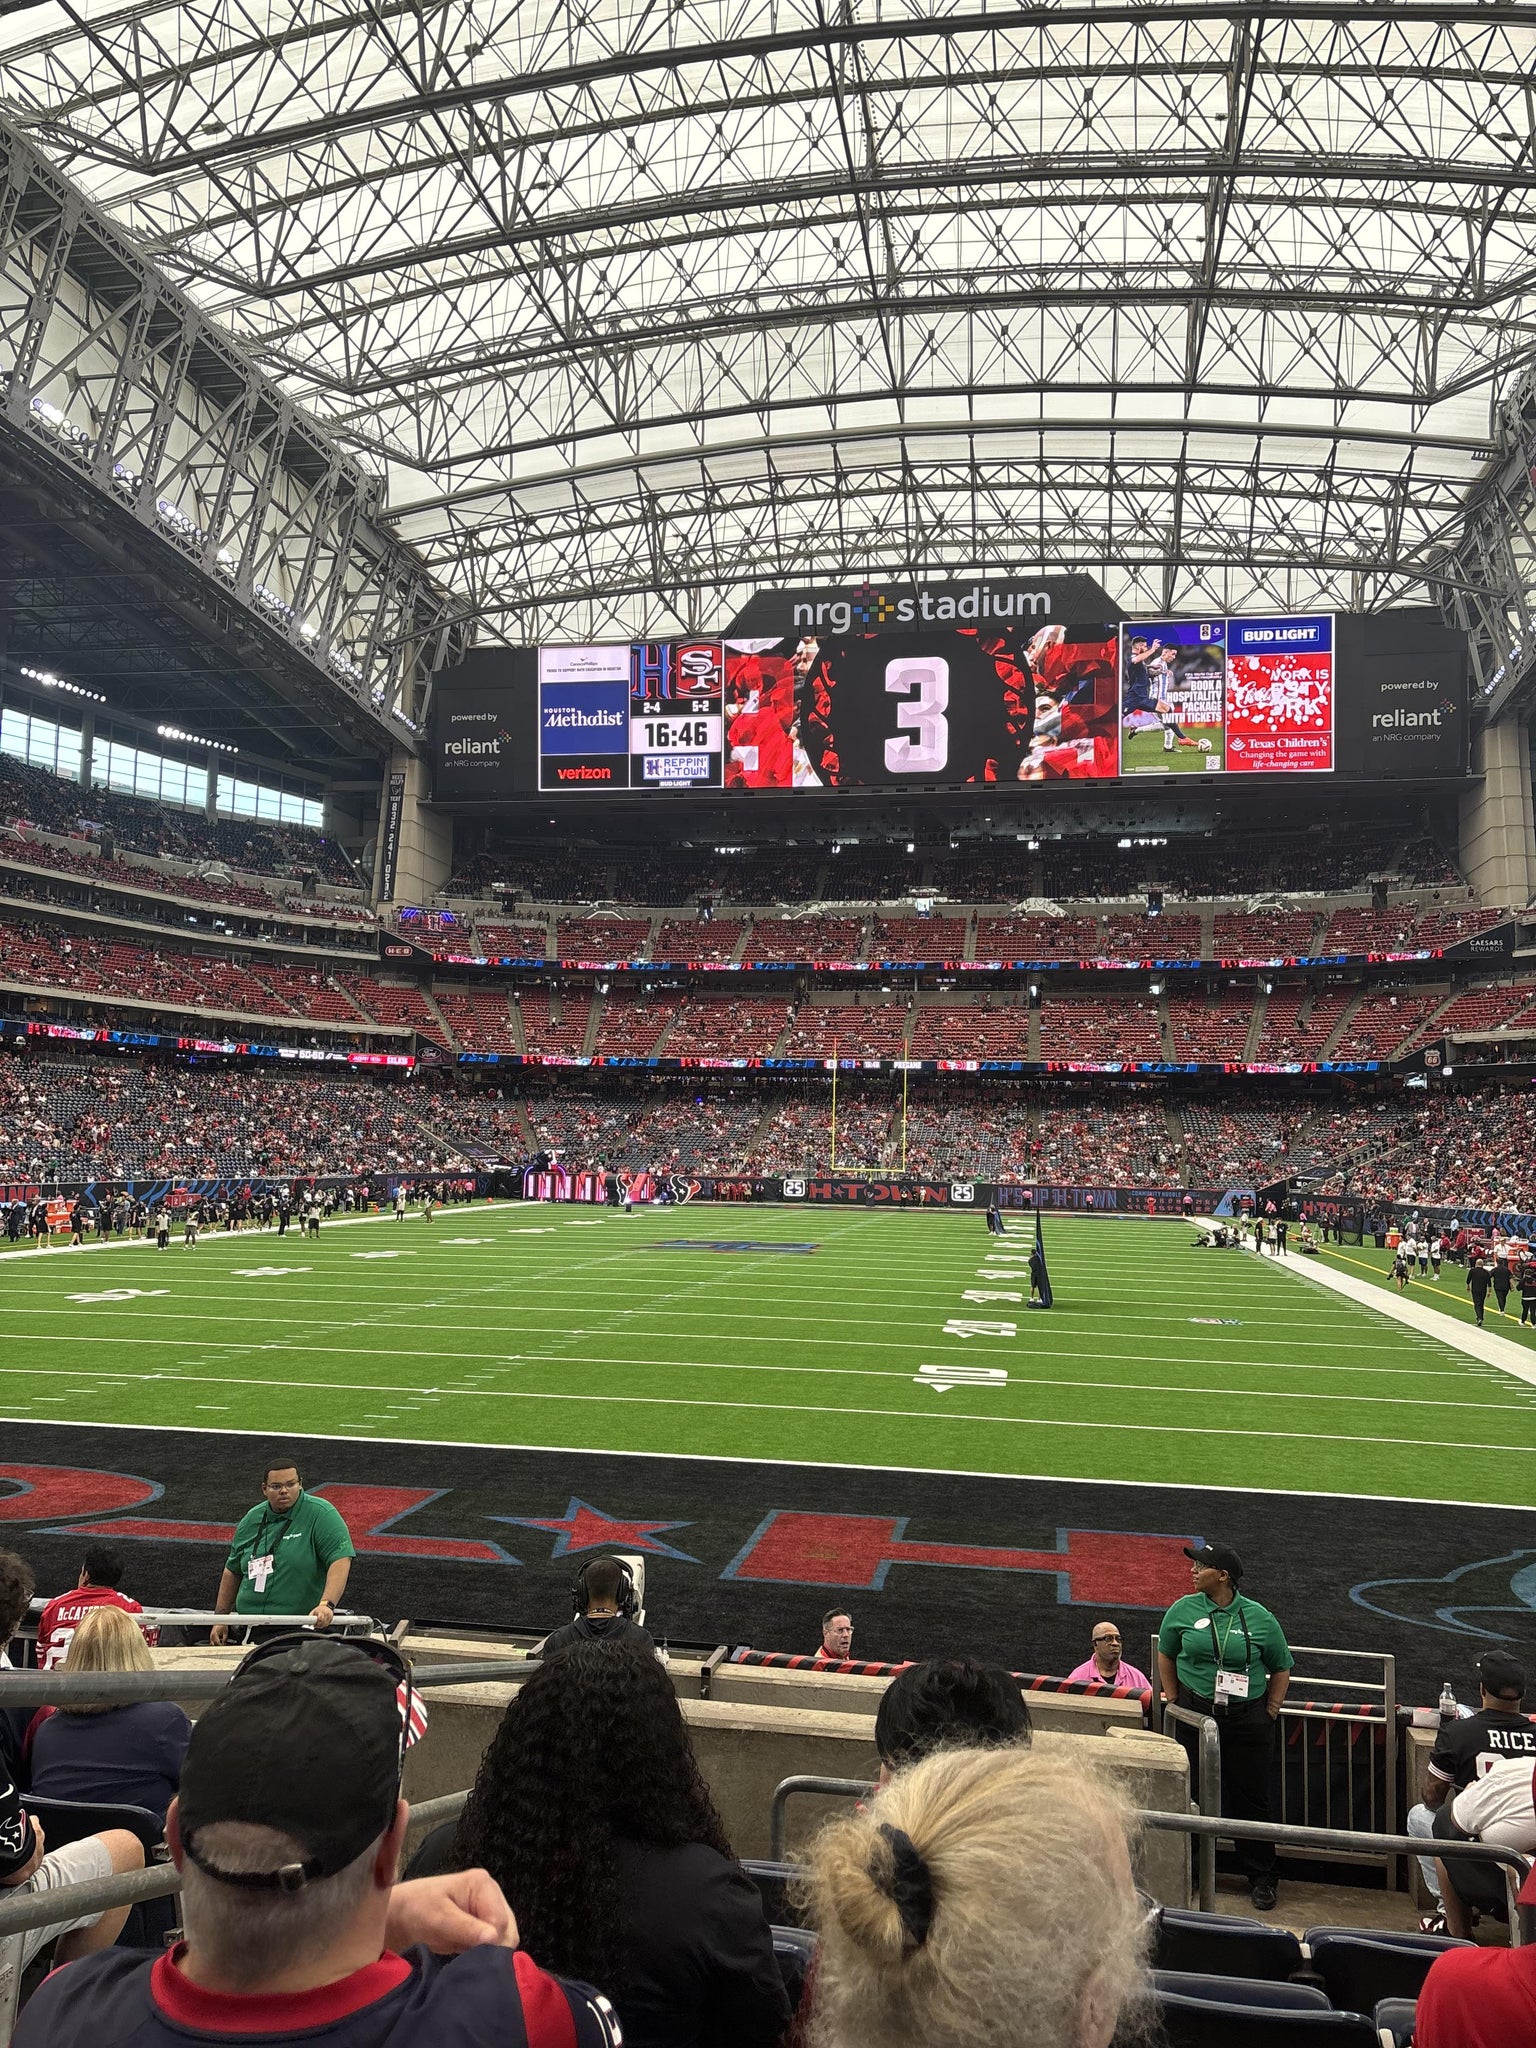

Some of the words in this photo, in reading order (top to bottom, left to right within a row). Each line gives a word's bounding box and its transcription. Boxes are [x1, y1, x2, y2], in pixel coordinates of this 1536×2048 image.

[793, 602, 850, 634] nrg
[897, 587, 1051, 621] stadium
[1244, 630, 1274, 641] BUD
[1275, 629, 1316, 640] LIGHT
[1191, 680, 1215, 691] BOOK
[1216, 680, 1222, 690] A
[1381, 681, 1424, 692] powered
[1427, 681, 1439, 690] by
[1166, 691, 1222, 702] HOSPITALITY
[643, 702, 660, 713] 2-4
[692, 701, 709, 712] 5-2
[1182, 701, 1222, 712] PACKAGE
[451, 713, 486, 723] powered
[488, 713, 497, 722] by
[544, 710, 623, 727] Methodist
[885, 657, 949, 773] 3
[1162, 712, 1186, 723] WITH
[1187, 711, 1222, 723] TICKETS
[1372, 709, 1442, 727] reliant
[645, 722, 707, 747] 16:46
[1404, 733, 1441, 741] company
[445, 738, 500, 754] reliant
[1248, 739, 1275, 749] Texas
[1277, 737, 1327, 748] Children's
[1240, 751, 1274, 759] Changing
[1309, 749, 1326, 757] with
[470, 760, 500, 768] company
[664, 758, 707, 767] REPPIN'
[1253, 760, 1298, 769] life-changing
[557, 766, 611, 780] verizon
[664, 767, 707, 777] H-TOWN
[57, 1605, 107, 1621] McCAF
[1487, 1729, 1536, 1751] RICE
